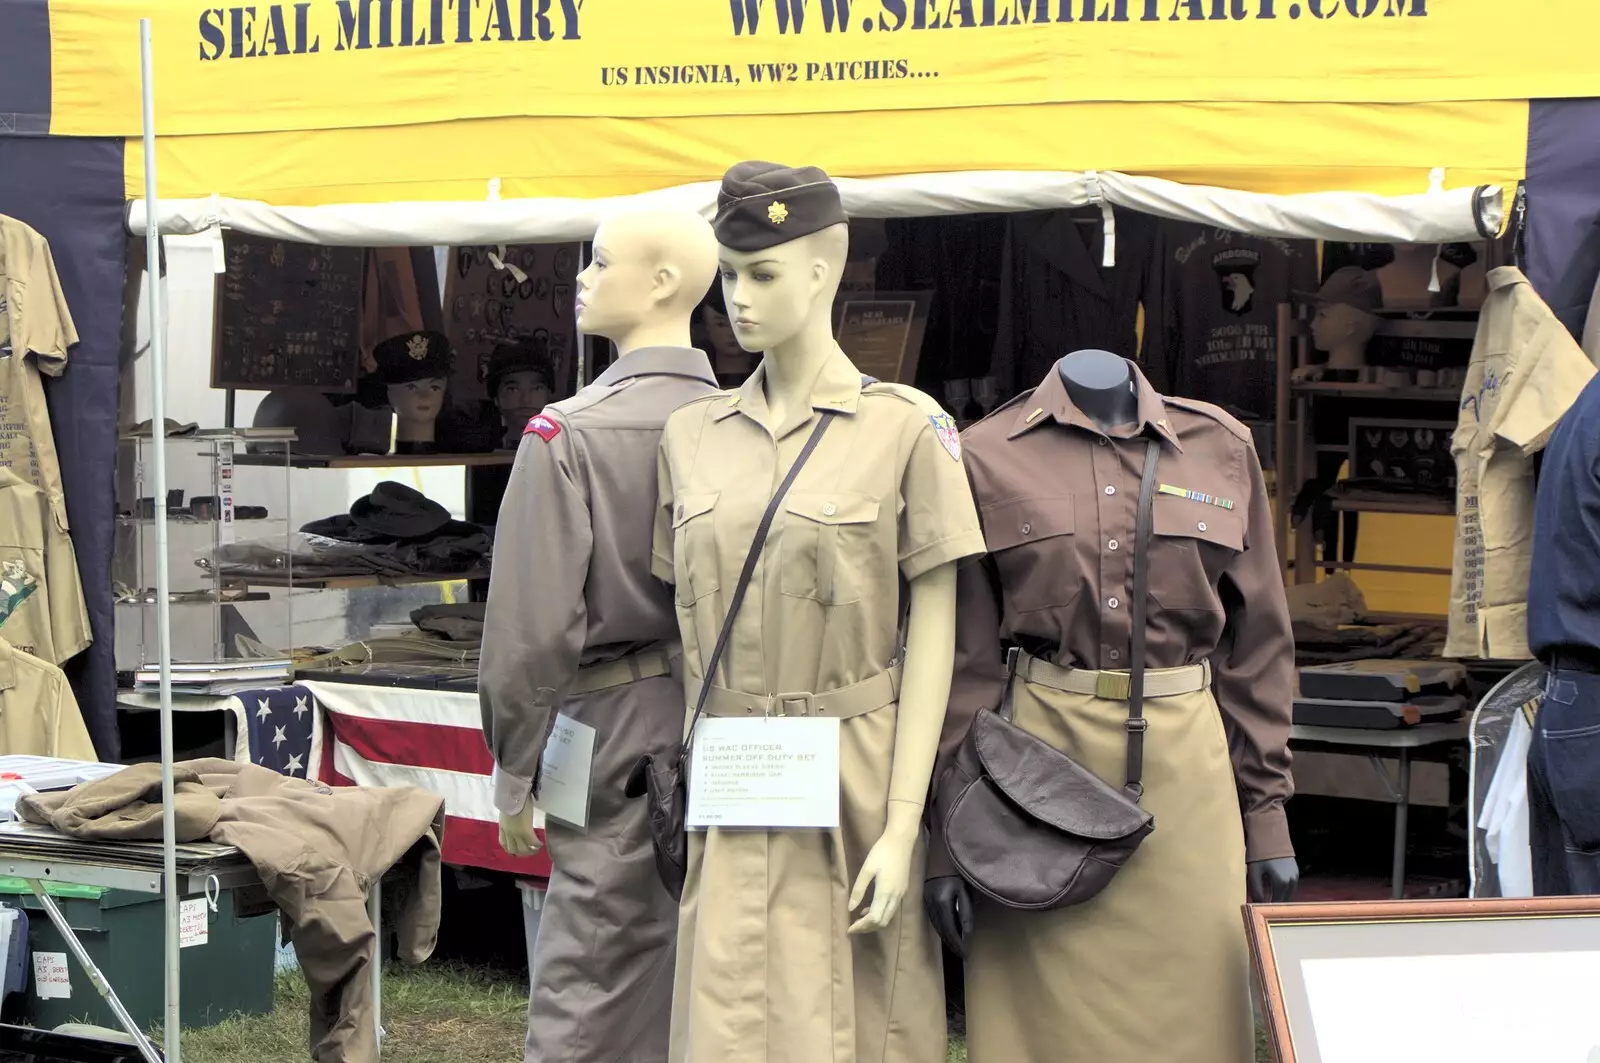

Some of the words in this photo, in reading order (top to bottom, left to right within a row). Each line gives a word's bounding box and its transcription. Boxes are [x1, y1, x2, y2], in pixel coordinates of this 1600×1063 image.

[199, 3, 319, 61] SEAL
[335, 0, 583, 51] MILITARY
[601, 67, 628, 86] US
[635, 65, 740, 86] INSIGNIA,
[749, 63, 798, 82] WW2
